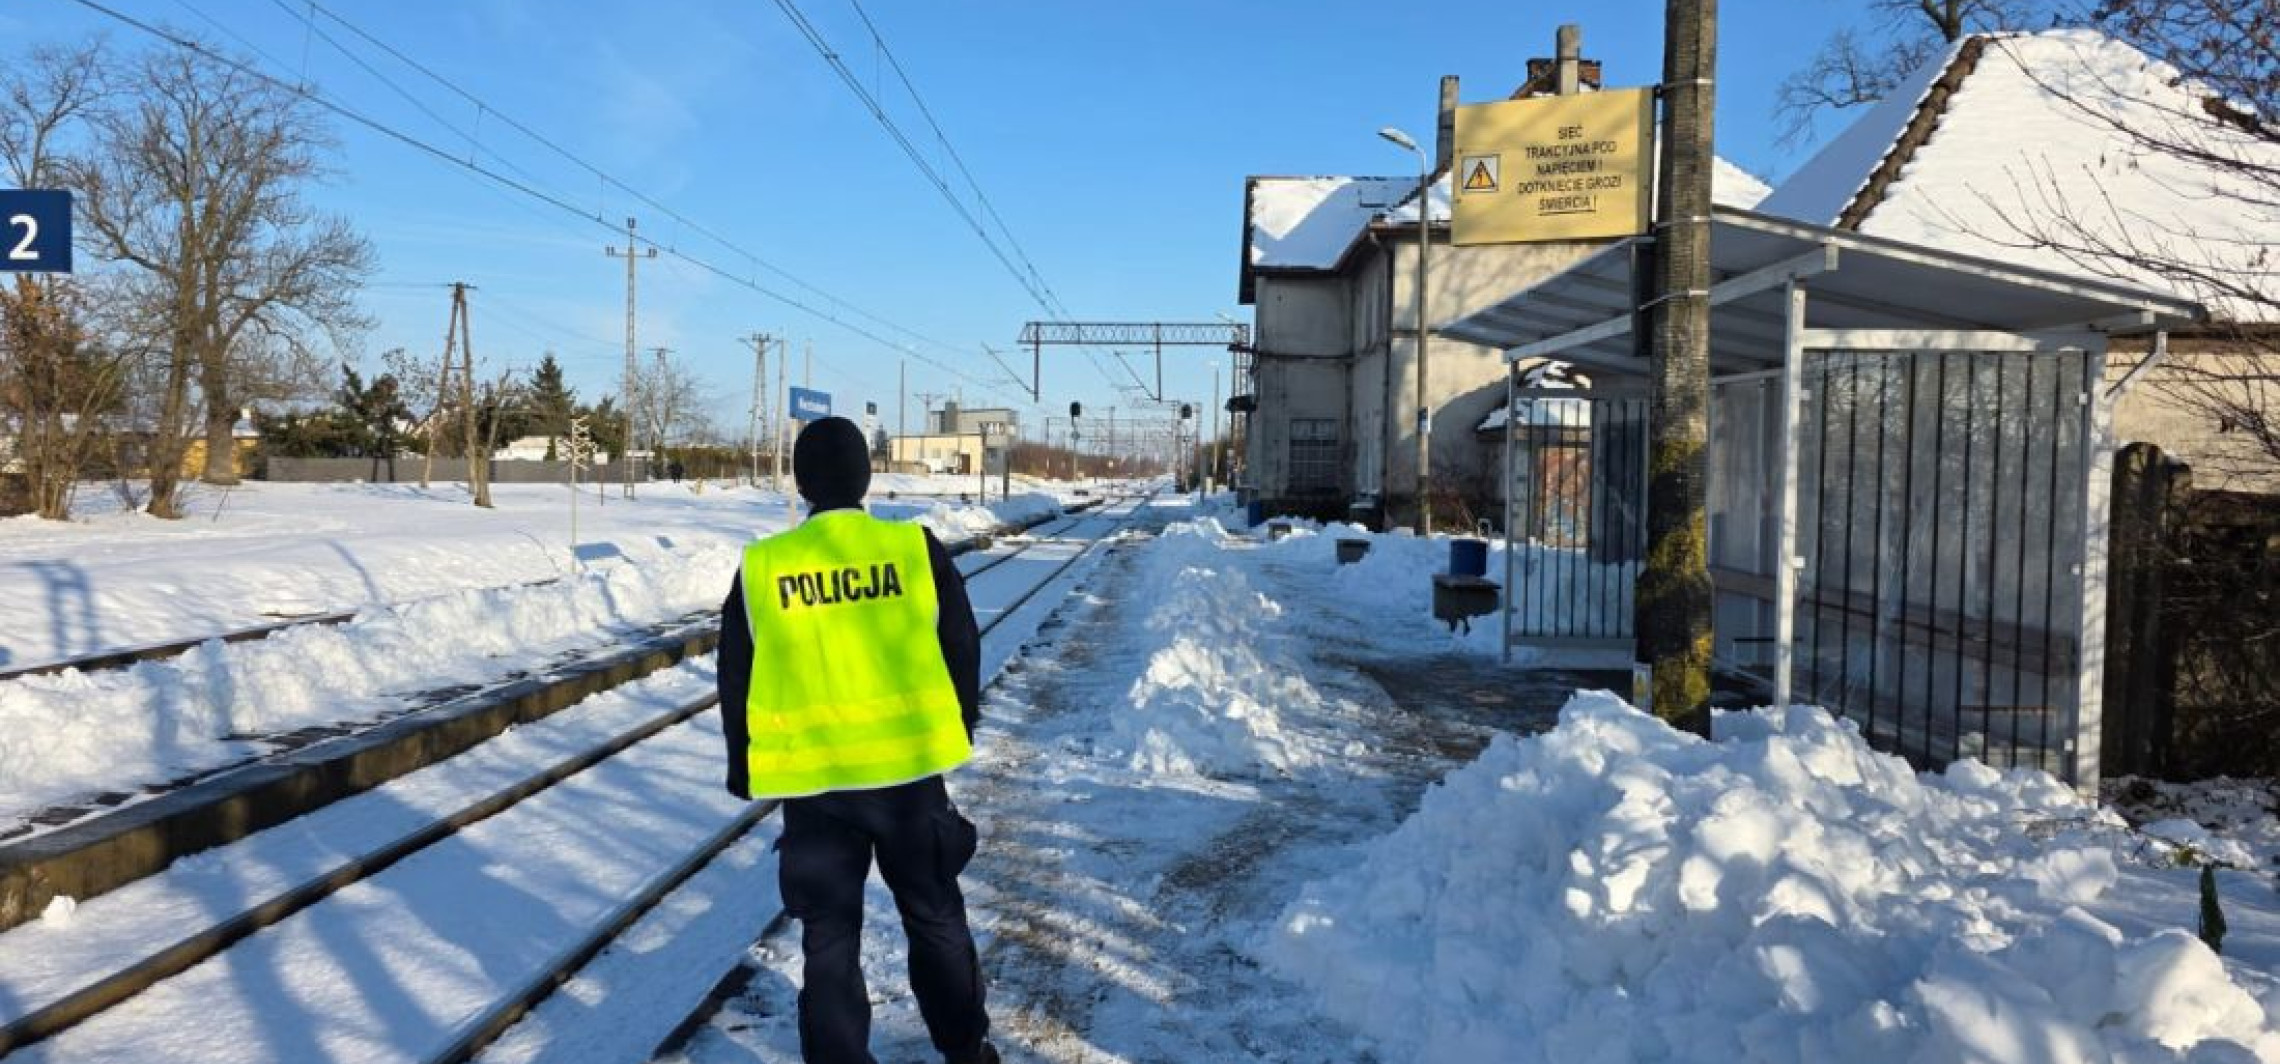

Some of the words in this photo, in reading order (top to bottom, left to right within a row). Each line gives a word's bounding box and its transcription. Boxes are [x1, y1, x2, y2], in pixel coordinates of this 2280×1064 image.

[1525, 142, 1590, 159] TRAKCYJNA
[1592, 140, 1617, 155] POD
[1586, 174, 1621, 191] GROZI
[9, 213, 39, 260] 2
[777, 562, 903, 610] POLICJA
